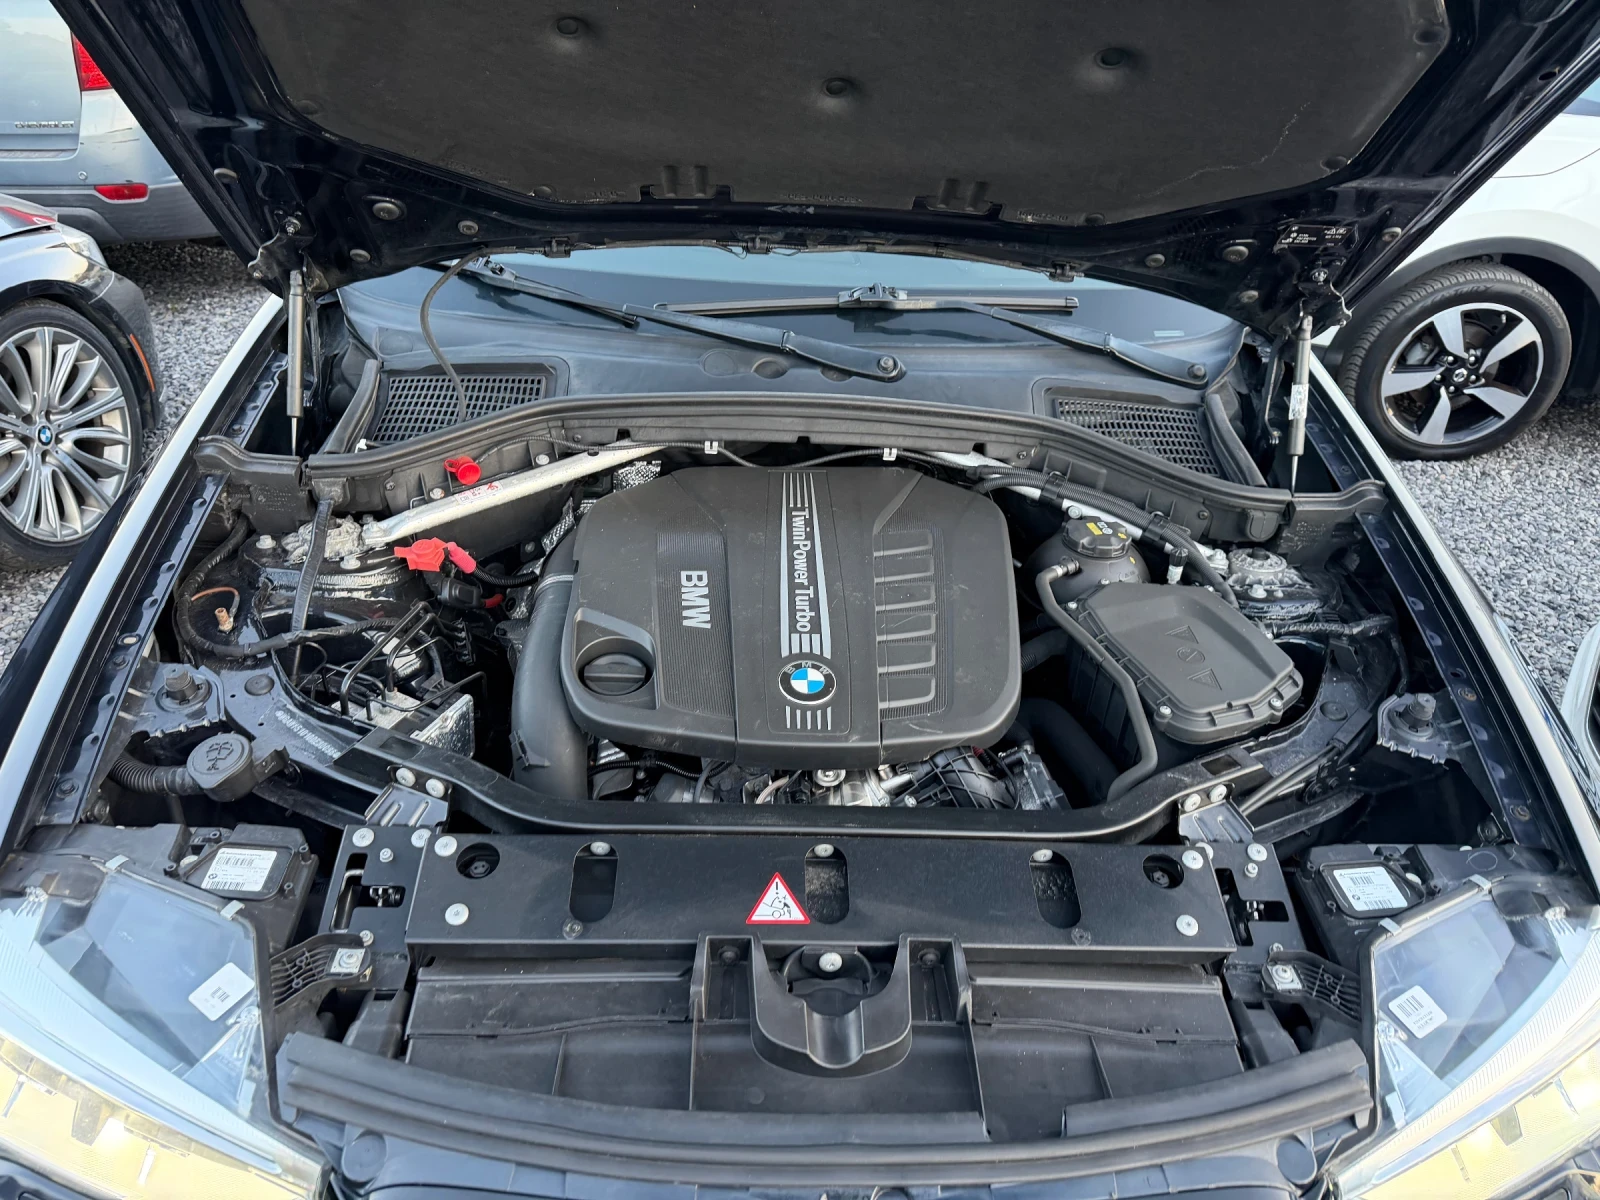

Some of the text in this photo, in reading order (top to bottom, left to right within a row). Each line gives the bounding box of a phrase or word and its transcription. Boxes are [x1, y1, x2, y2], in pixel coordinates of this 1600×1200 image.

[14, 120, 74, 129] CHEVROLET
[791, 508, 816, 632] TwinPower Turbo
[680, 570, 712, 629] BMW
[784, 660, 830, 675] BMW
